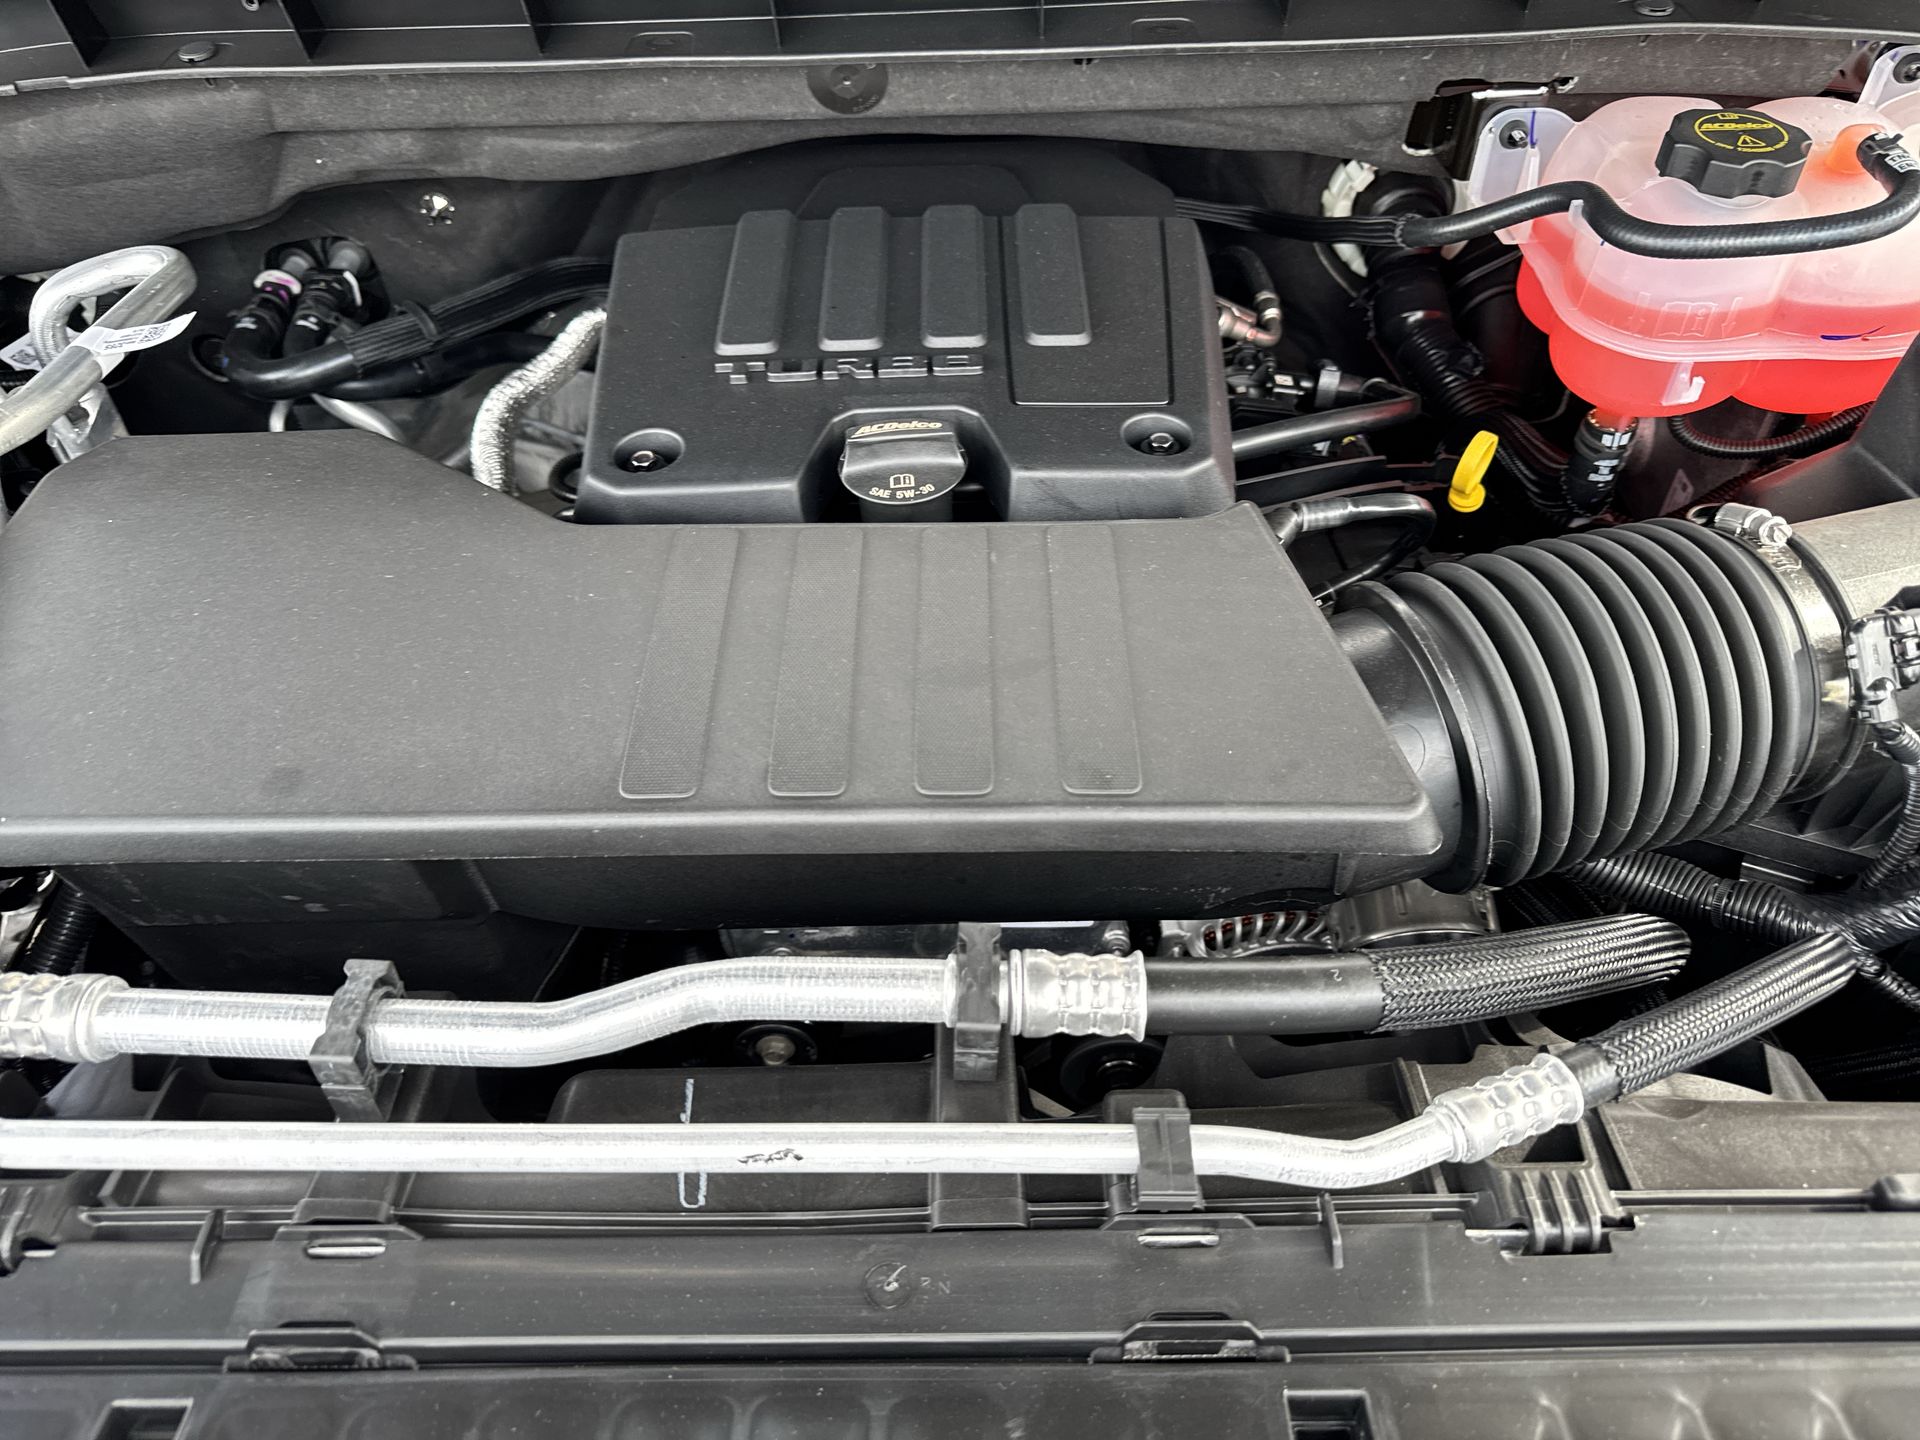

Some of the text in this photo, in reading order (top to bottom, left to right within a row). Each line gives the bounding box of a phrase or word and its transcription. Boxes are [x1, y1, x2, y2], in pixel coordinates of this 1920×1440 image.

[714, 354, 984, 385] TURBO
[851, 420, 943, 438] ACDelco
[868, 483, 936, 499] SAE 5W-30
